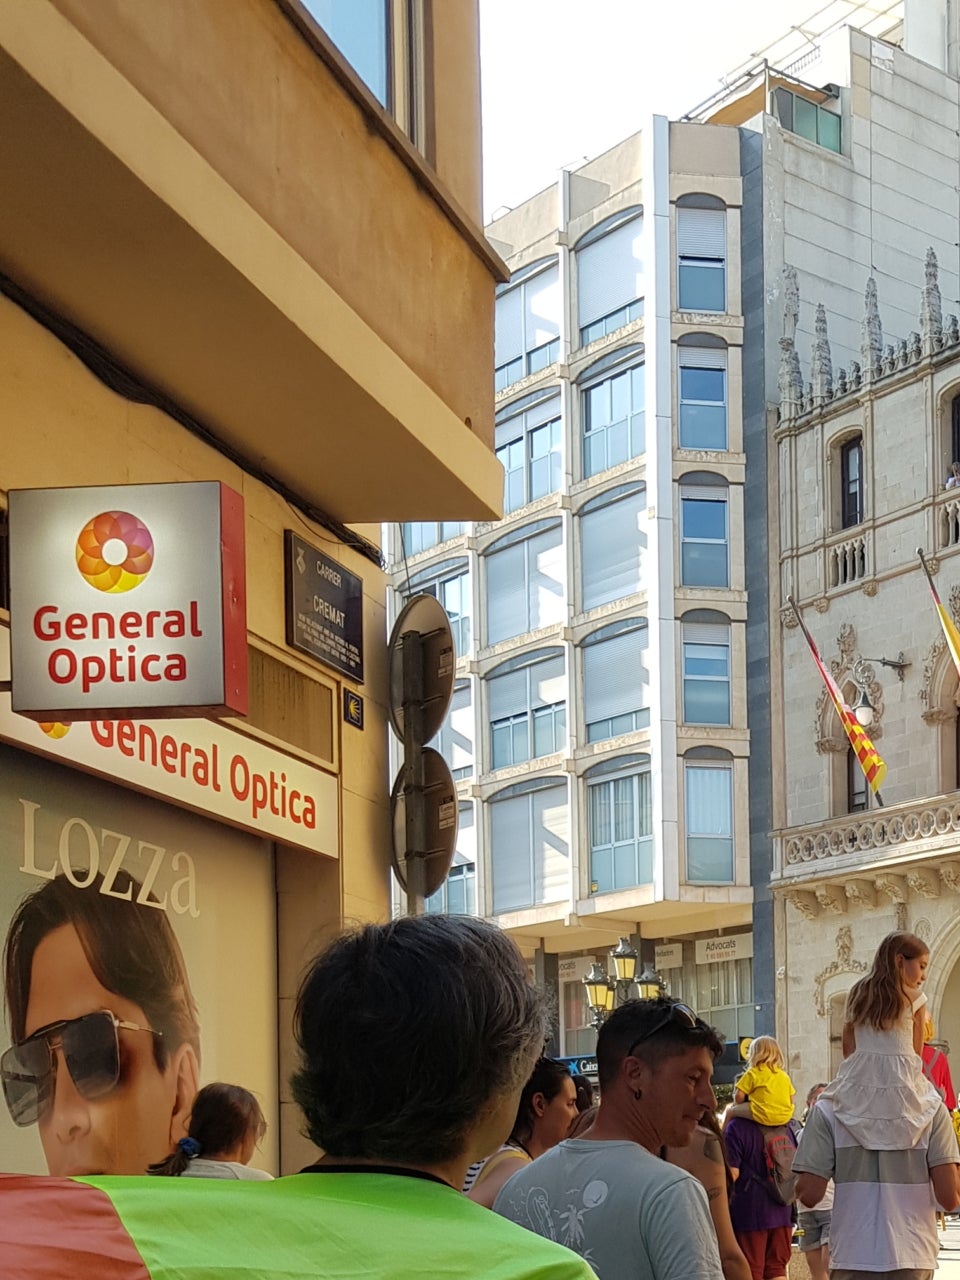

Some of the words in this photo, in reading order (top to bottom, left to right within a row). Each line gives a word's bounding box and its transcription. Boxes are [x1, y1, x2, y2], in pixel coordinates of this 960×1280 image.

[316, 560, 342, 589] CARRER
[33, 601, 203, 642] General
[313, 595, 346, 629] CREMAT
[48, 645, 187, 693] Optica
[230, 754, 317, 830] Optica
[705, 939, 737, 951] Advocats
